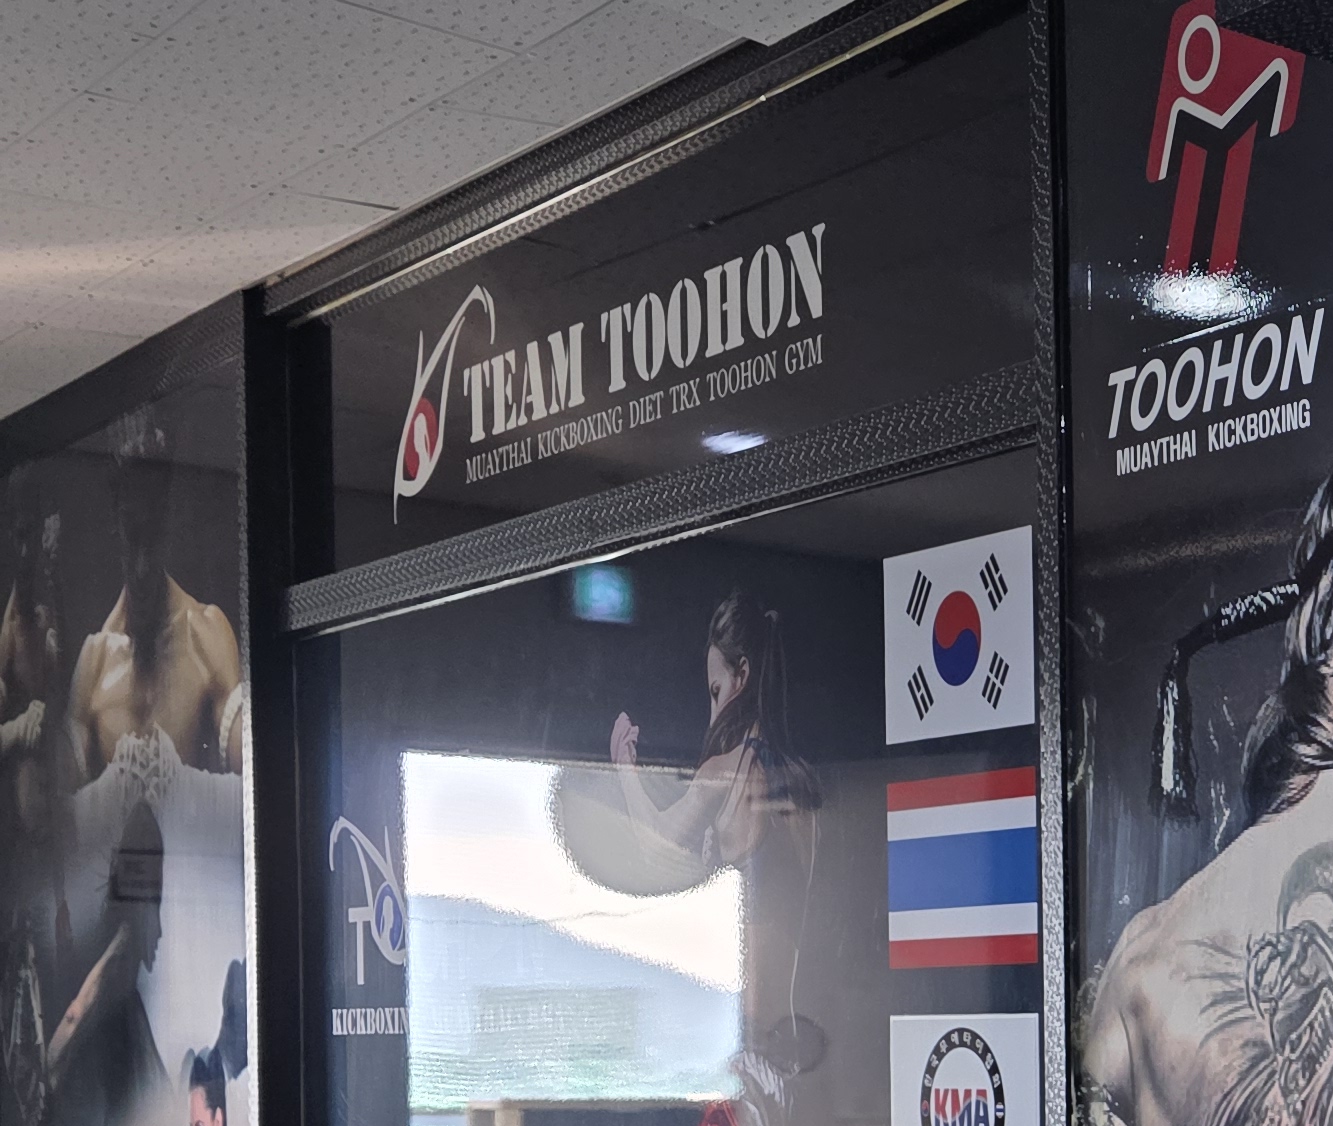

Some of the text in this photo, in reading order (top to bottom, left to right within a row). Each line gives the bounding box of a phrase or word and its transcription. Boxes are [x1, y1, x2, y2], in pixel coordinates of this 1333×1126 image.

[463, 222, 826, 443] TEAM TOOHON
[1107, 307, 1325, 439] TOOHON
[465, 334, 824, 484] MUAYTHAI KICKBOXING DIET TRX TOOHON GYM
[1115, 398, 1311, 477] MUAYTHAI KICKBOXING
